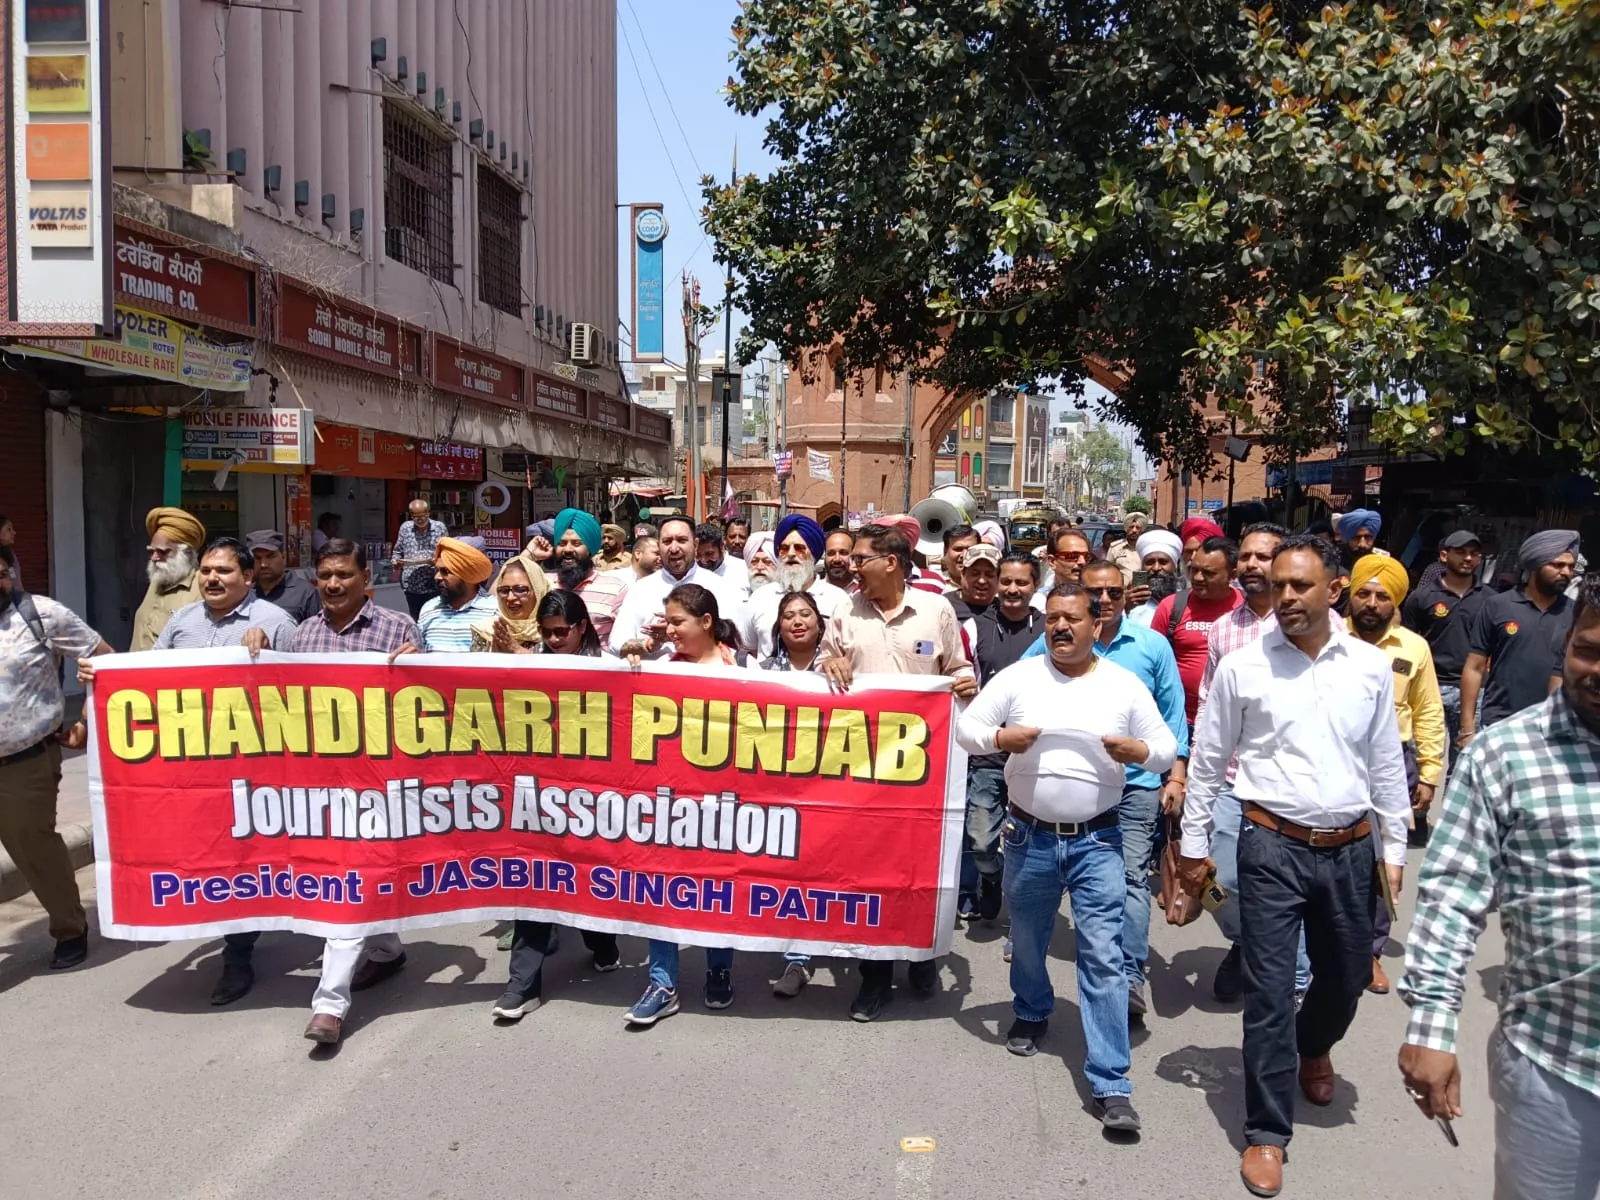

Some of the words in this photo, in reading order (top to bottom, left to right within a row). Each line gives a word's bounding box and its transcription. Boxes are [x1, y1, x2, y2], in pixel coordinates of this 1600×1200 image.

[29, 207, 87, 221] VOLTAS
[30, 223, 35, 231] A
[36, 223, 57, 231] TATA
[60, 223, 87, 231] Product
[168, 251, 203, 286] ਕੰਪਨੀ
[120, 272, 173, 305] TRADING
[179, 290, 198, 311] CO.
[113, 308, 168, 339] OOLER
[91, 344, 150, 369] WHOLESALE
[153, 355, 176, 374] RATE
[307, 328, 331, 349] SODHI
[334, 335, 362, 358] MOBILE
[364, 345, 392, 366] GALLERY
[184, 411, 233, 426] MOBILE
[237, 412, 297, 428] FINANCE
[477, 529, 514, 538] MOBILE
[485, 538, 517, 547] CESSORIES
[486, 551, 514, 559] OBILE
[1185, 621, 1213, 630] ESSE
[106, 685, 611, 762] CHANDIGARH
[630, 693, 930, 785] PUNJAB
[231, 777, 502, 841] Journalists
[510, 774, 799, 859] Association
[150, 863, 364, 907] President
[408, 857, 577, 898] JASBIR
[589, 866, 734, 914] SINGH
[749, 882, 882, 928] PATTI
